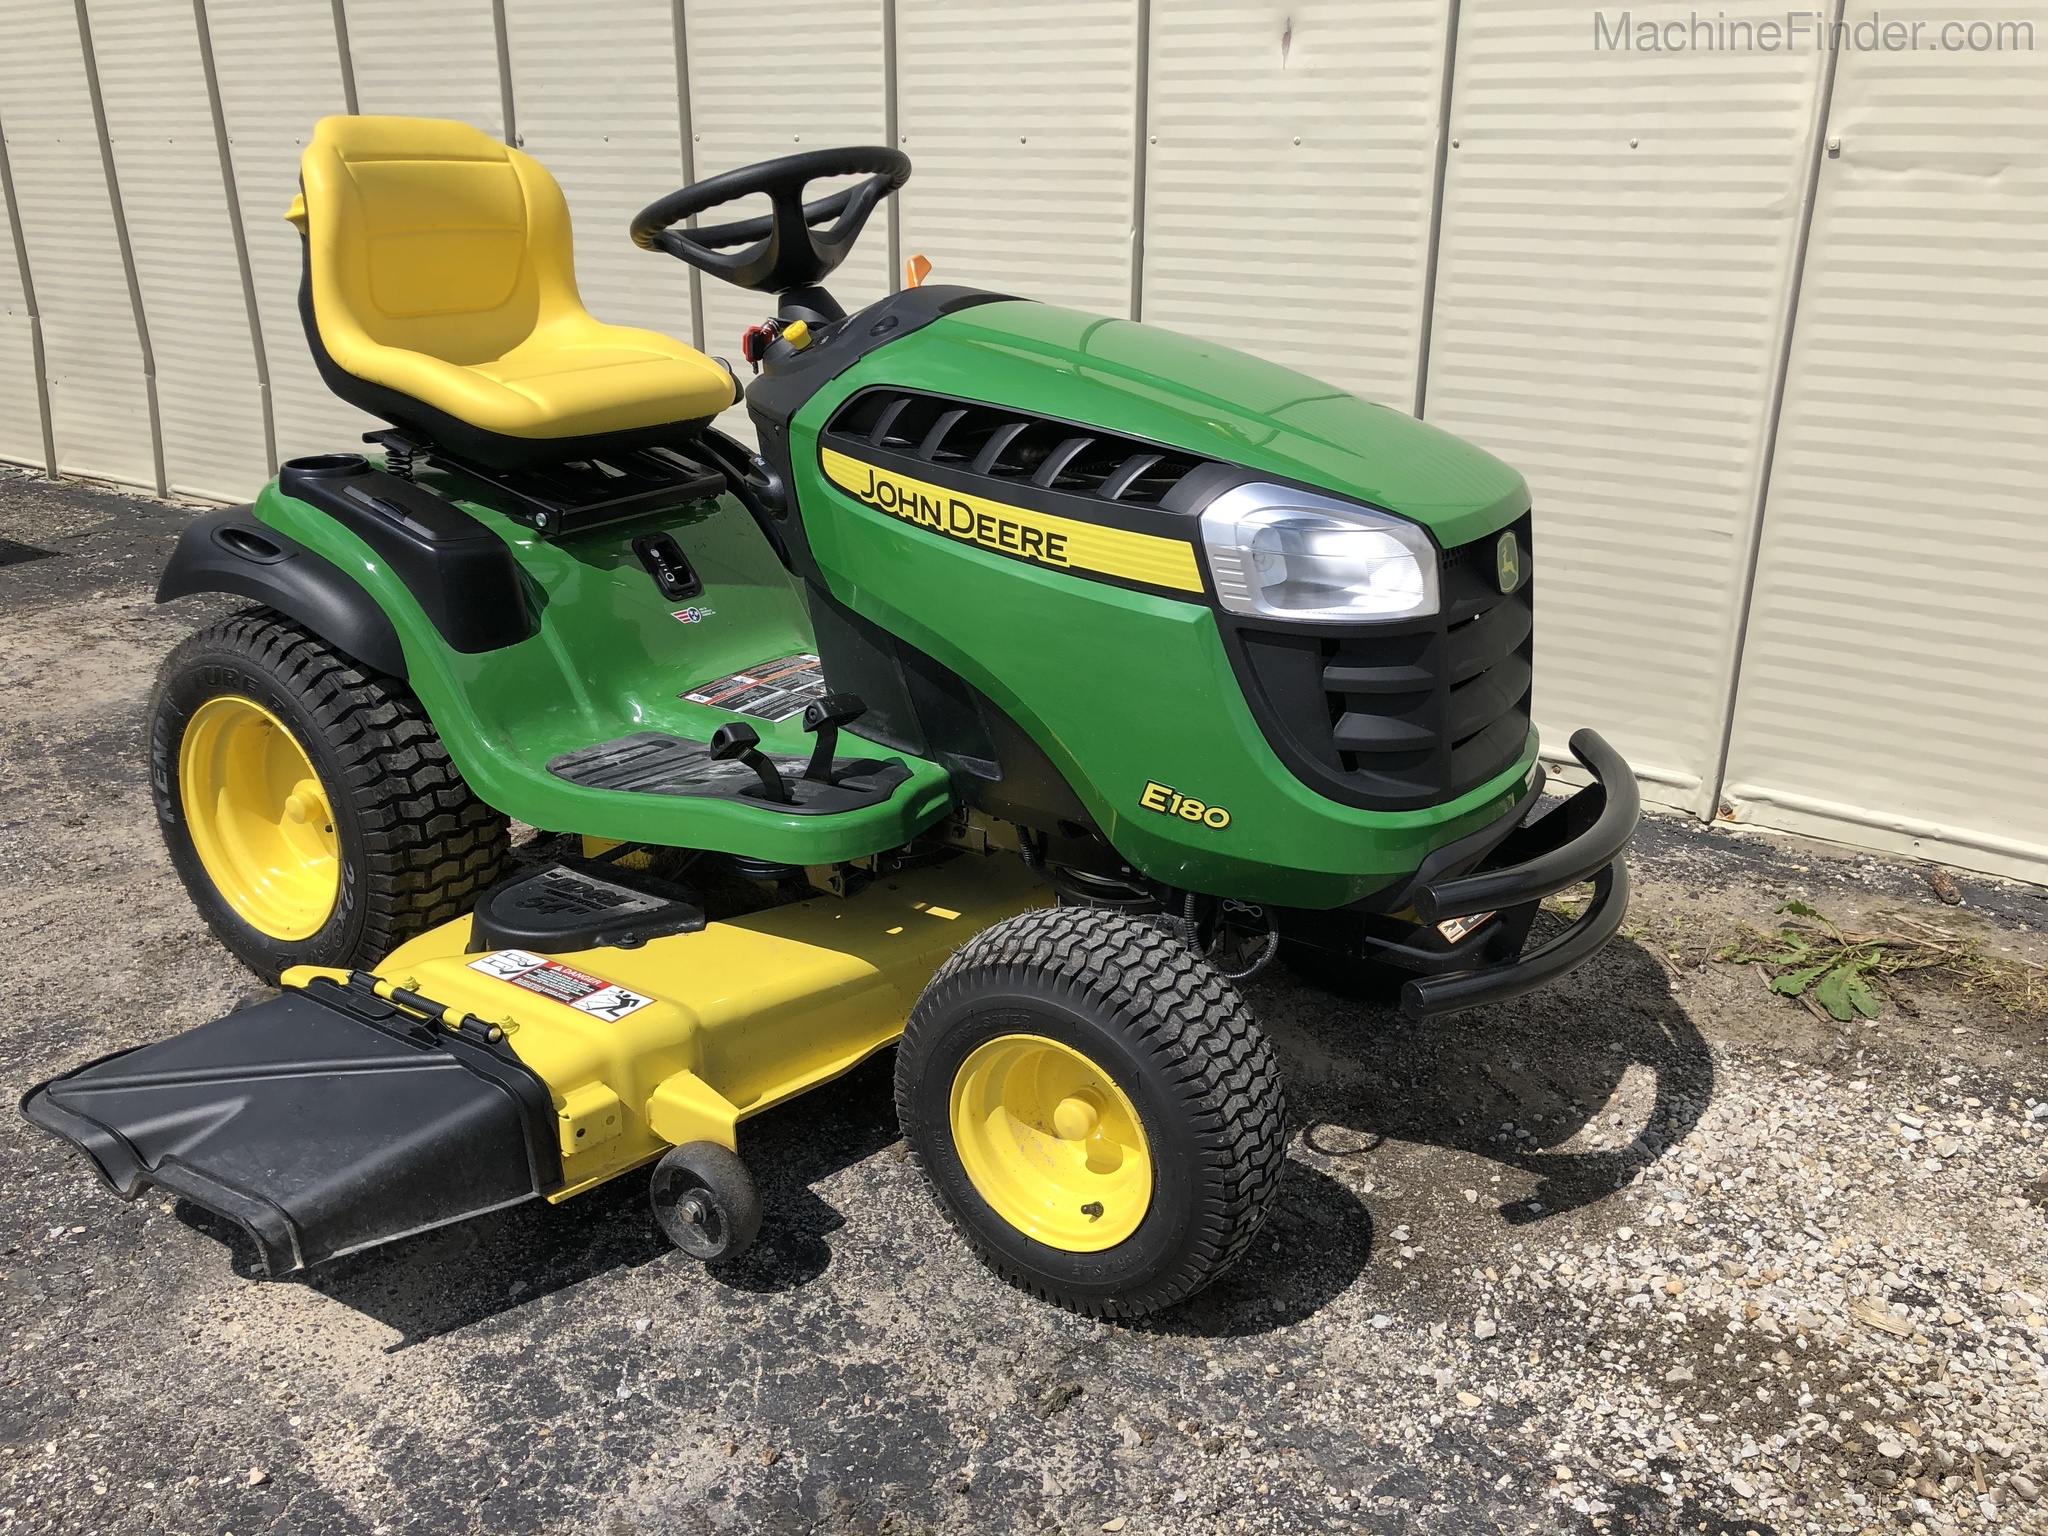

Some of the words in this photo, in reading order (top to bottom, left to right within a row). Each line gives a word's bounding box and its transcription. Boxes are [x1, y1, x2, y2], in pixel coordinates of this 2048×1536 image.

[860, 469, 942, 527] JOHN
[949, 498, 1068, 563] DEERE
[1139, 779, 1231, 830] E180
[561, 967, 602, 986] DANGER
